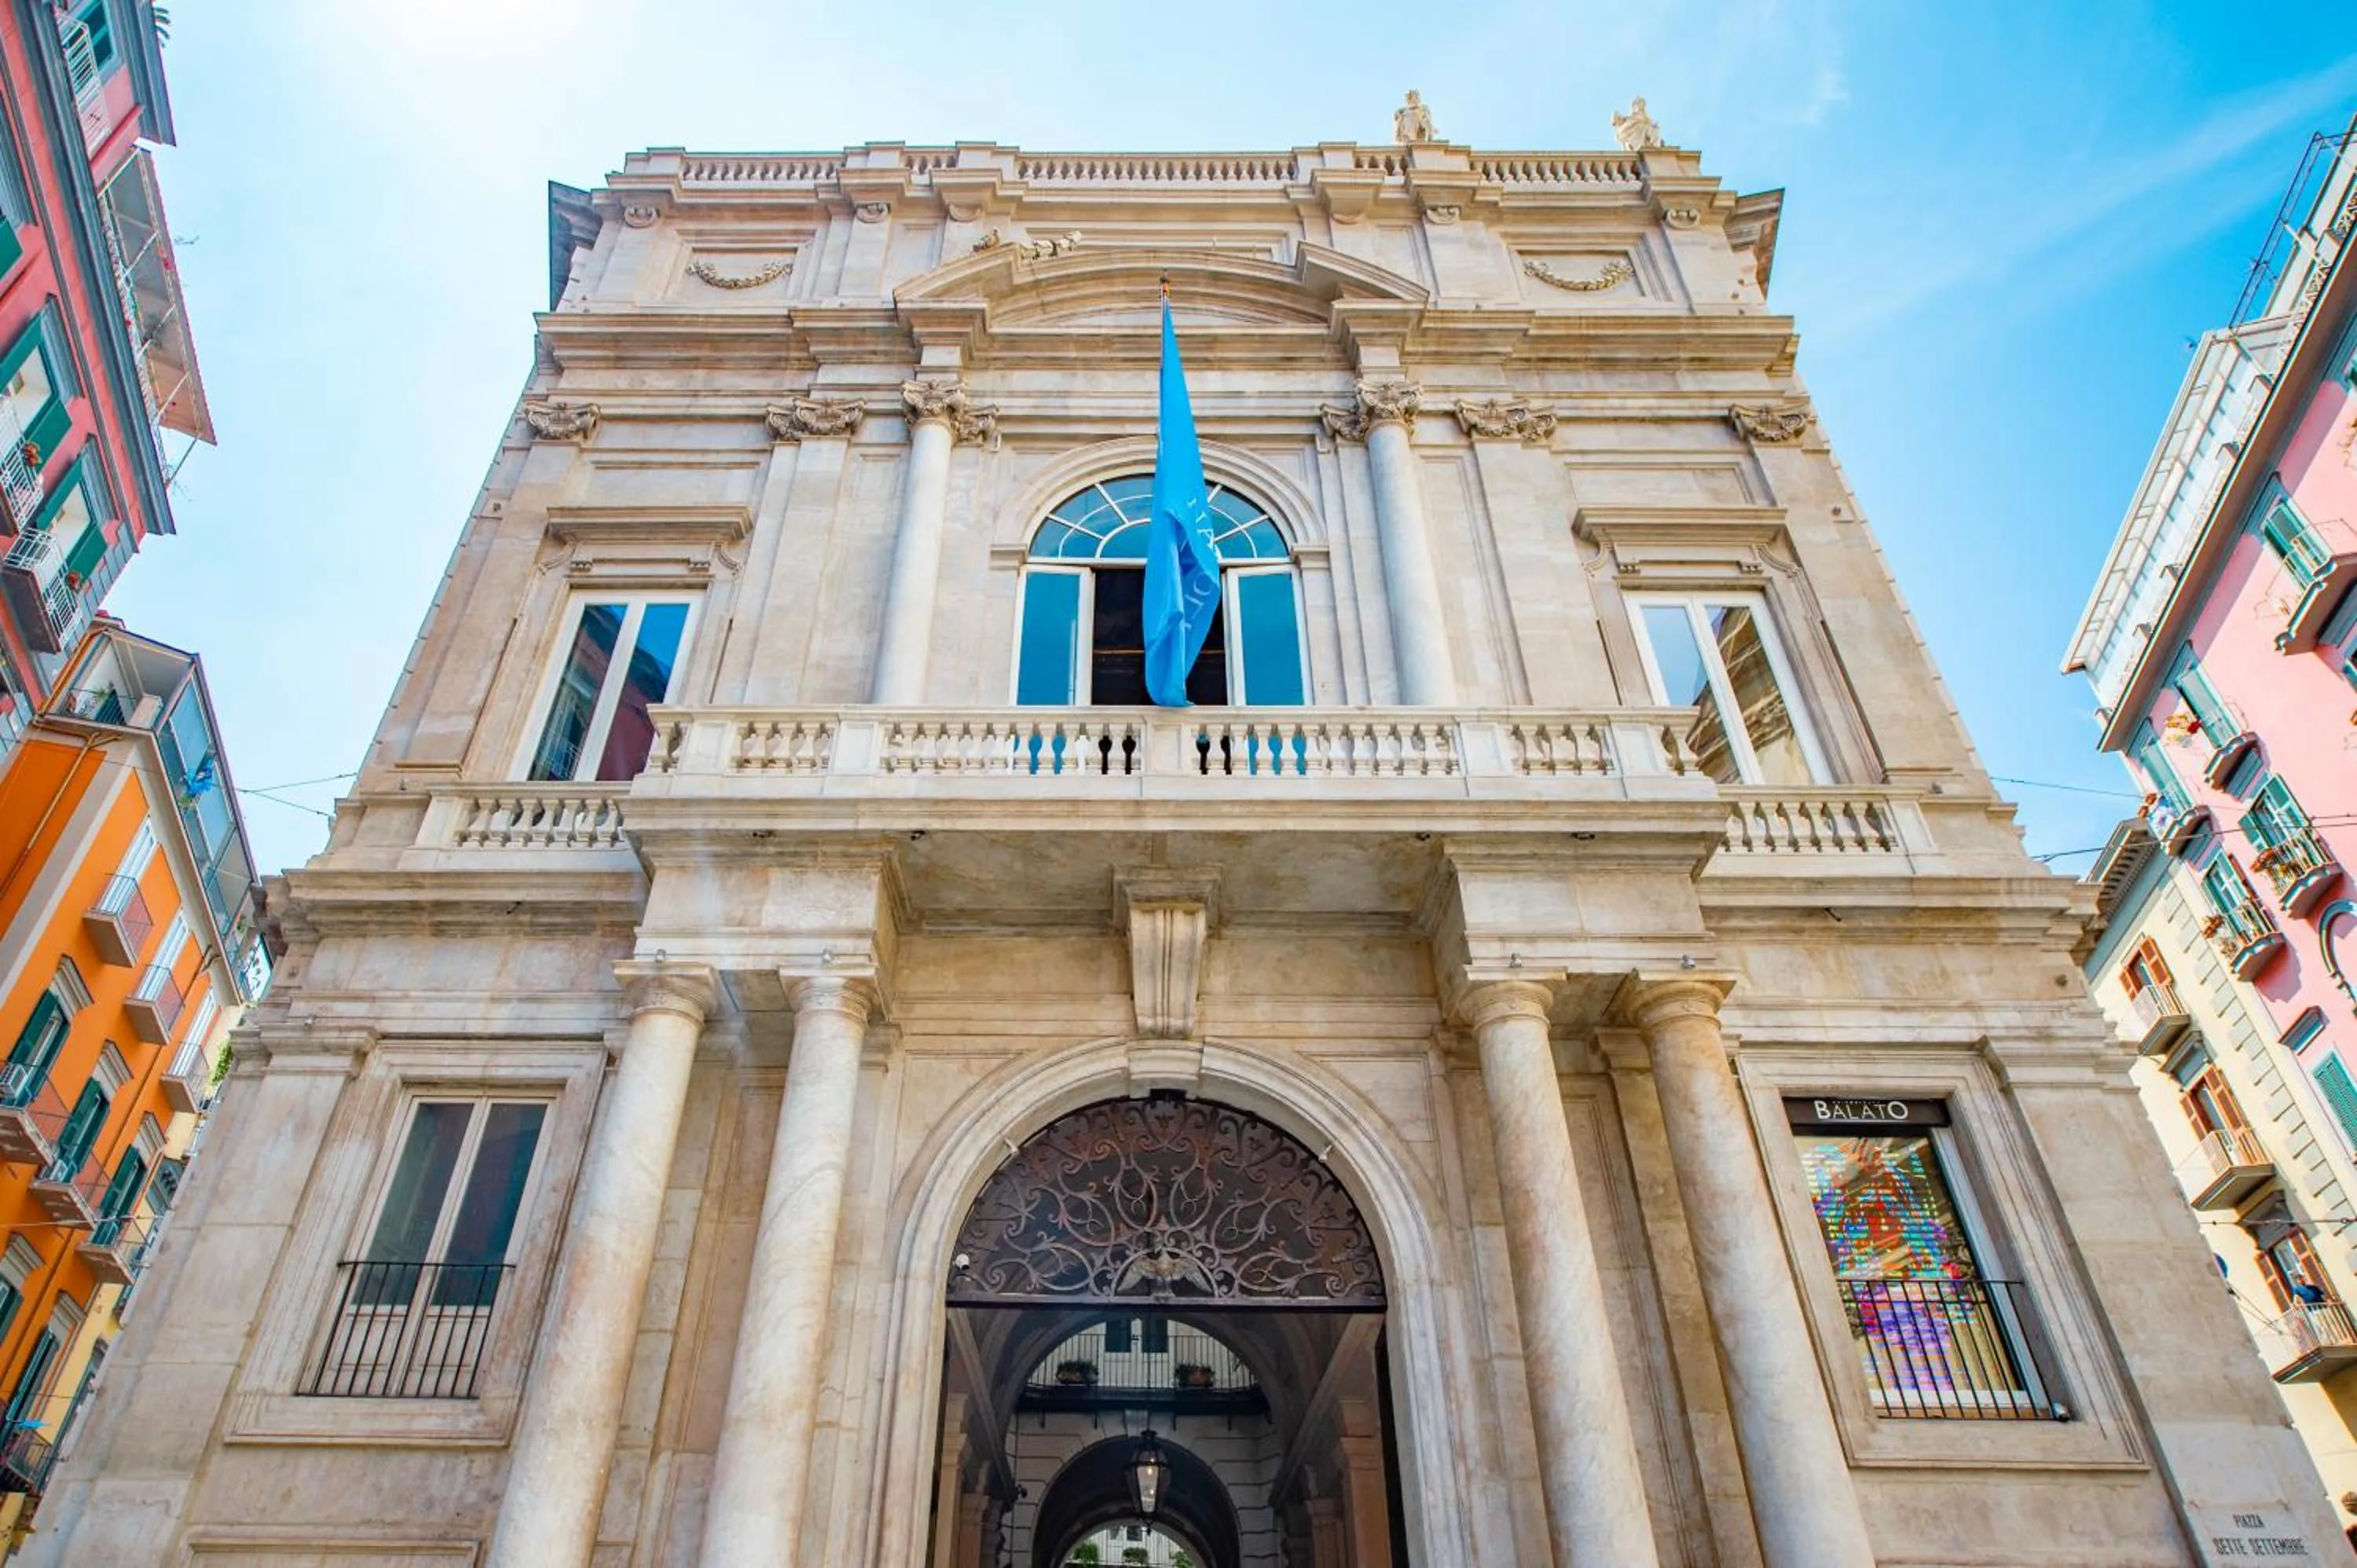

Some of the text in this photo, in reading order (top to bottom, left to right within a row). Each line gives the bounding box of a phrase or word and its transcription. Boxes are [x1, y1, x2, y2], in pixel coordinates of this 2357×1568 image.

[1813, 1100, 1908, 1119] BALATO
[2232, 1514, 2265, 1528] PIAZZA
[2212, 1537, 2248, 1555] SETTE
